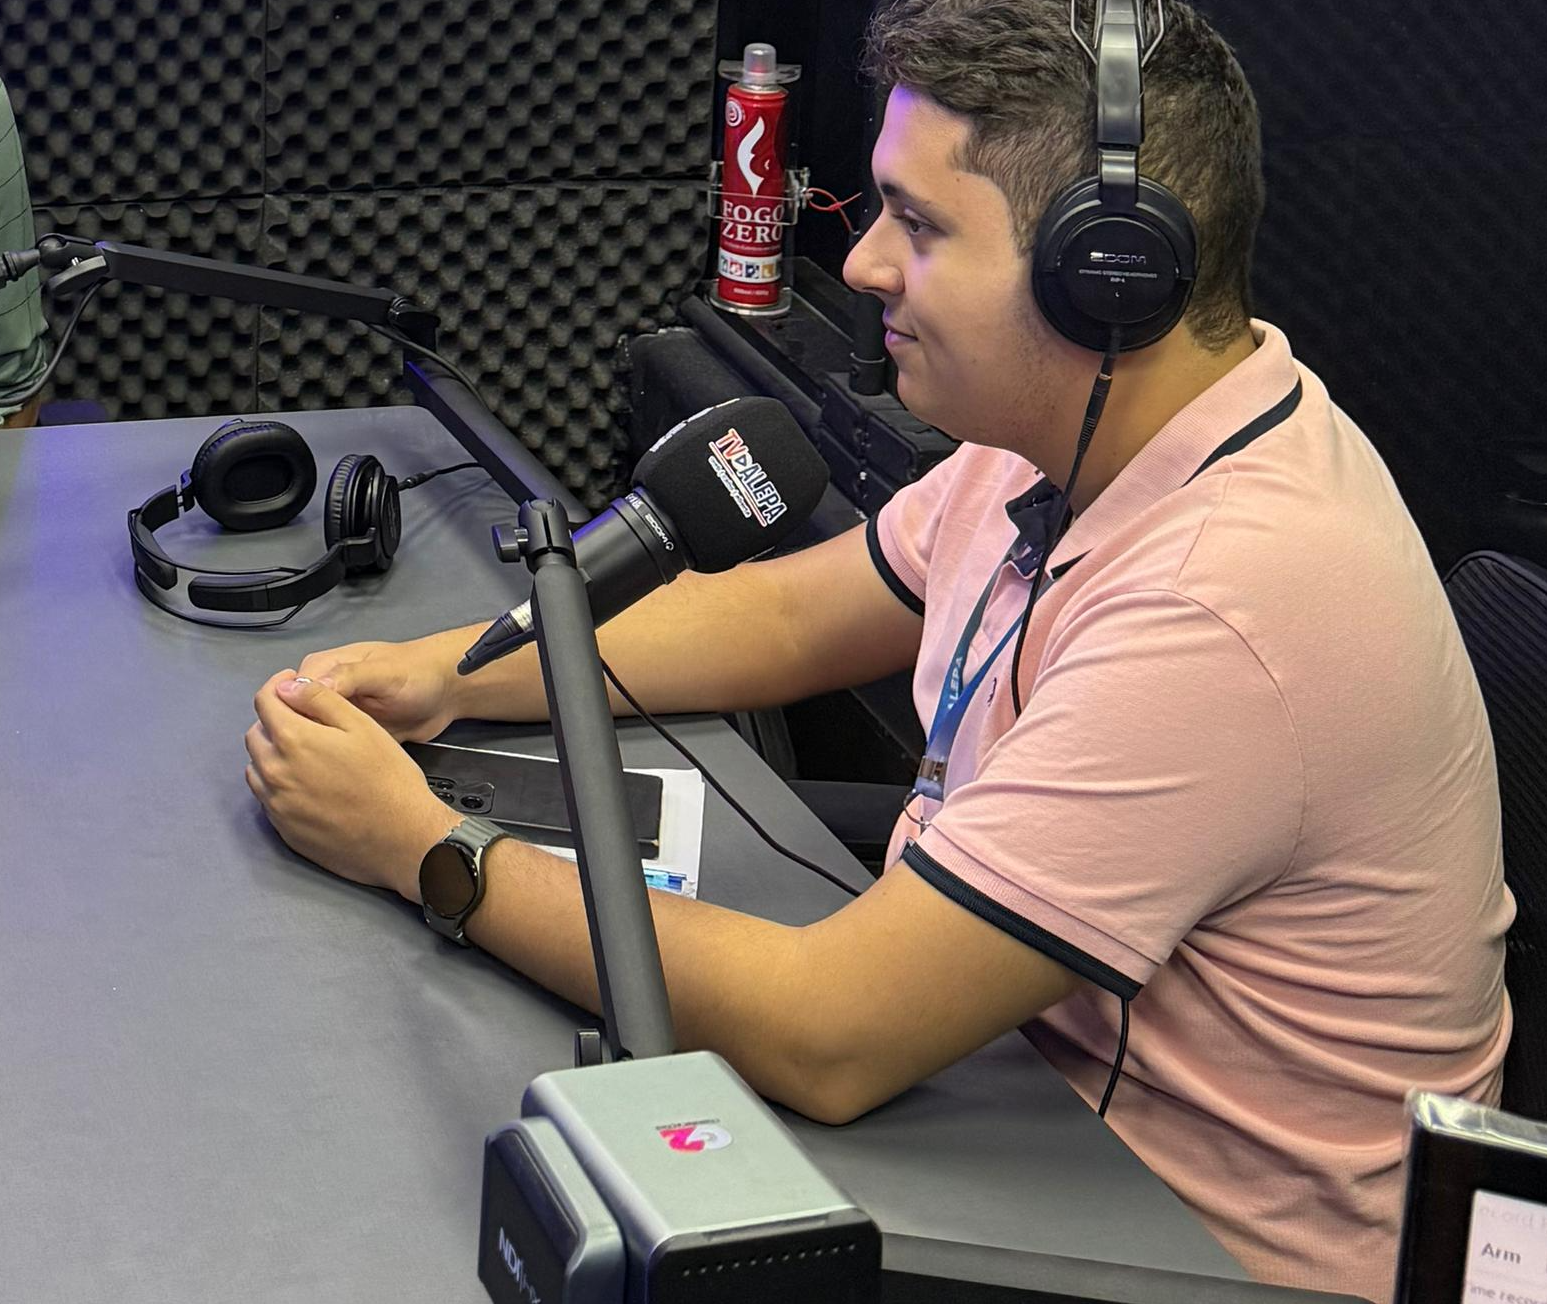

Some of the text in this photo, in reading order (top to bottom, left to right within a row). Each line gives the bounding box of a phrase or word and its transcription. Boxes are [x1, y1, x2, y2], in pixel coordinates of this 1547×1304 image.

[722, 199, 785, 224] FOGO
[721, 221, 784, 244] ZERO
[1089, 251, 1147, 265] ZOOM
[715, 427, 789, 526] TV ALEPA
[644, 513, 669, 545] ZOOM
[947, 656, 964, 710] LEPA
[1480, 1241, 1521, 1264] Arm
